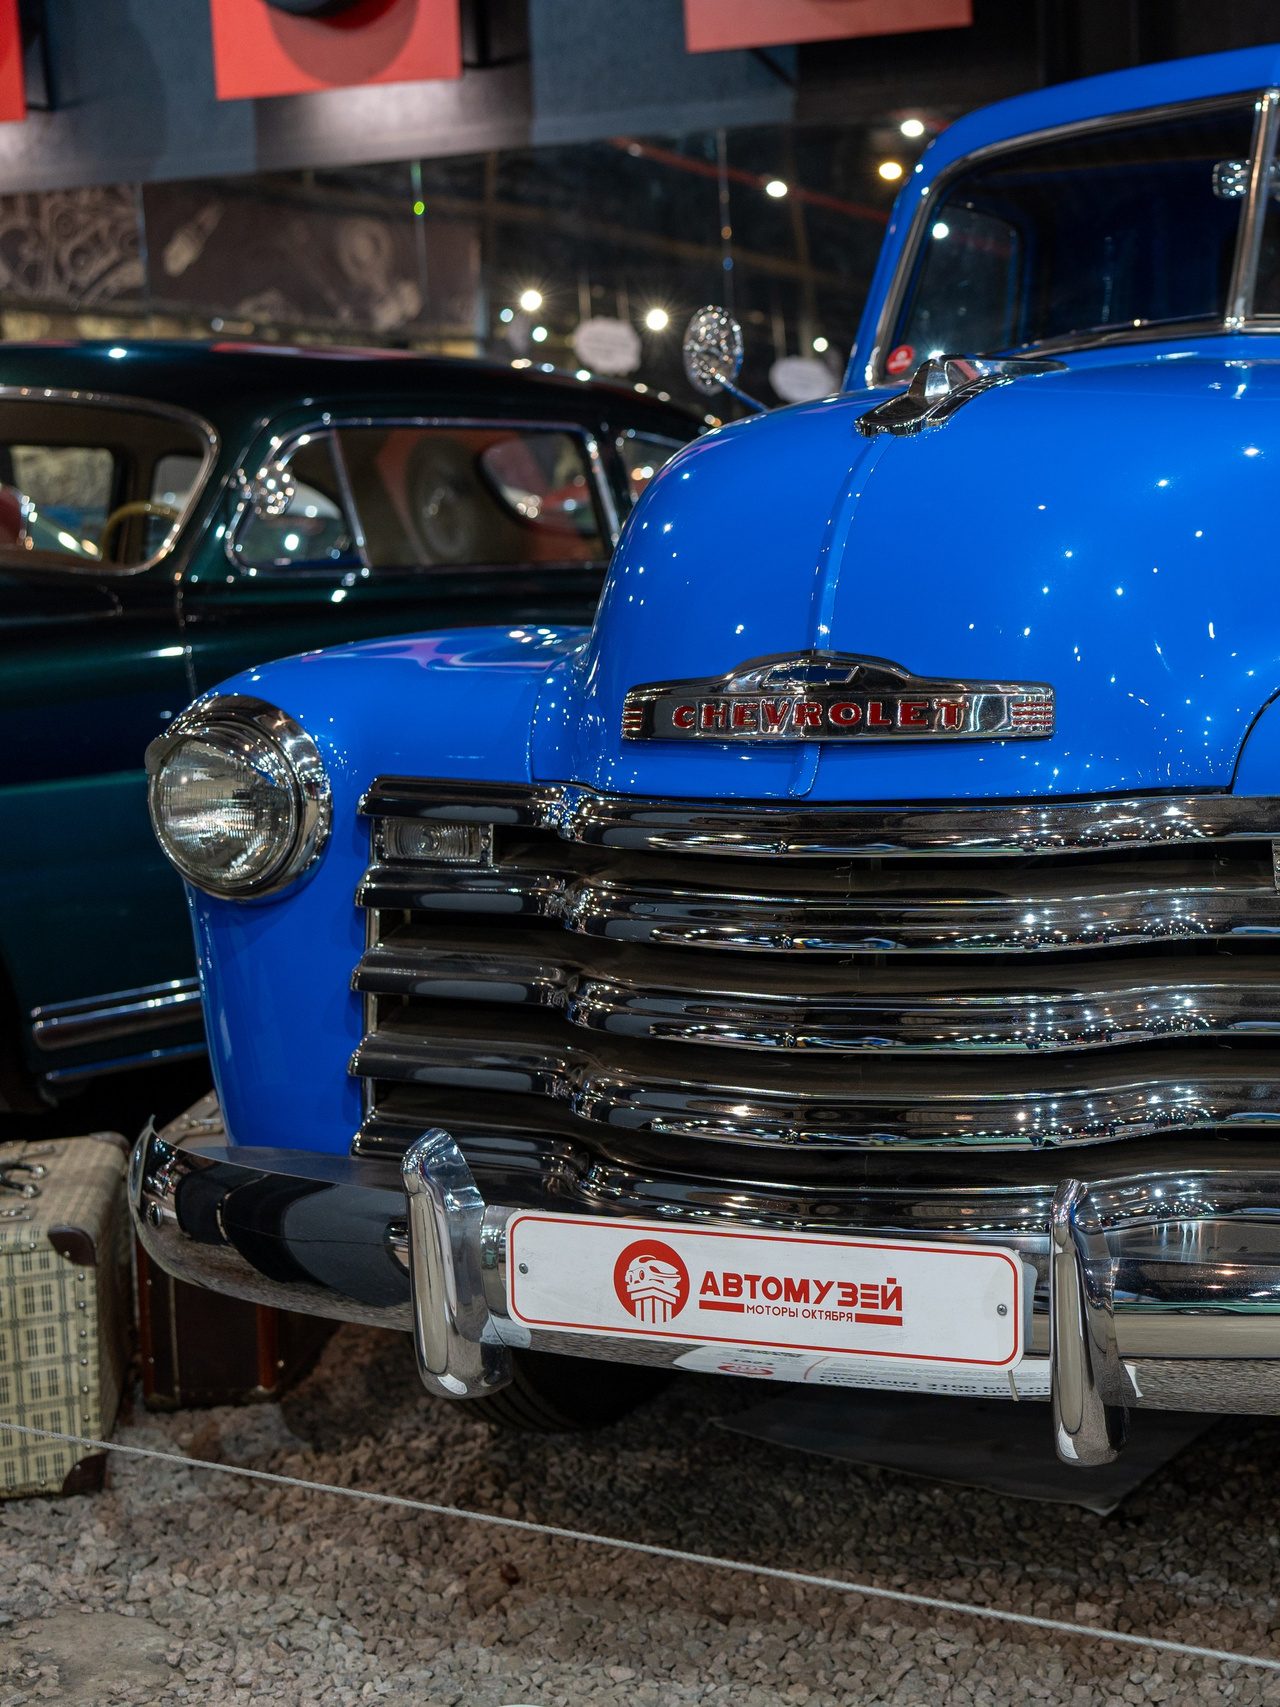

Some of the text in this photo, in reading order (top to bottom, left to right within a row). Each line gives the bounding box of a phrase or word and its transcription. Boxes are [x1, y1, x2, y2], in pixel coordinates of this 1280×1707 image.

[672, 700, 969, 731] CHEVROLET
[699, 1270, 903, 1311] АВТОМУЗЕЙ
[746, 1304, 853, 1323] МОТОРЫ ОКТЯБРЯ
